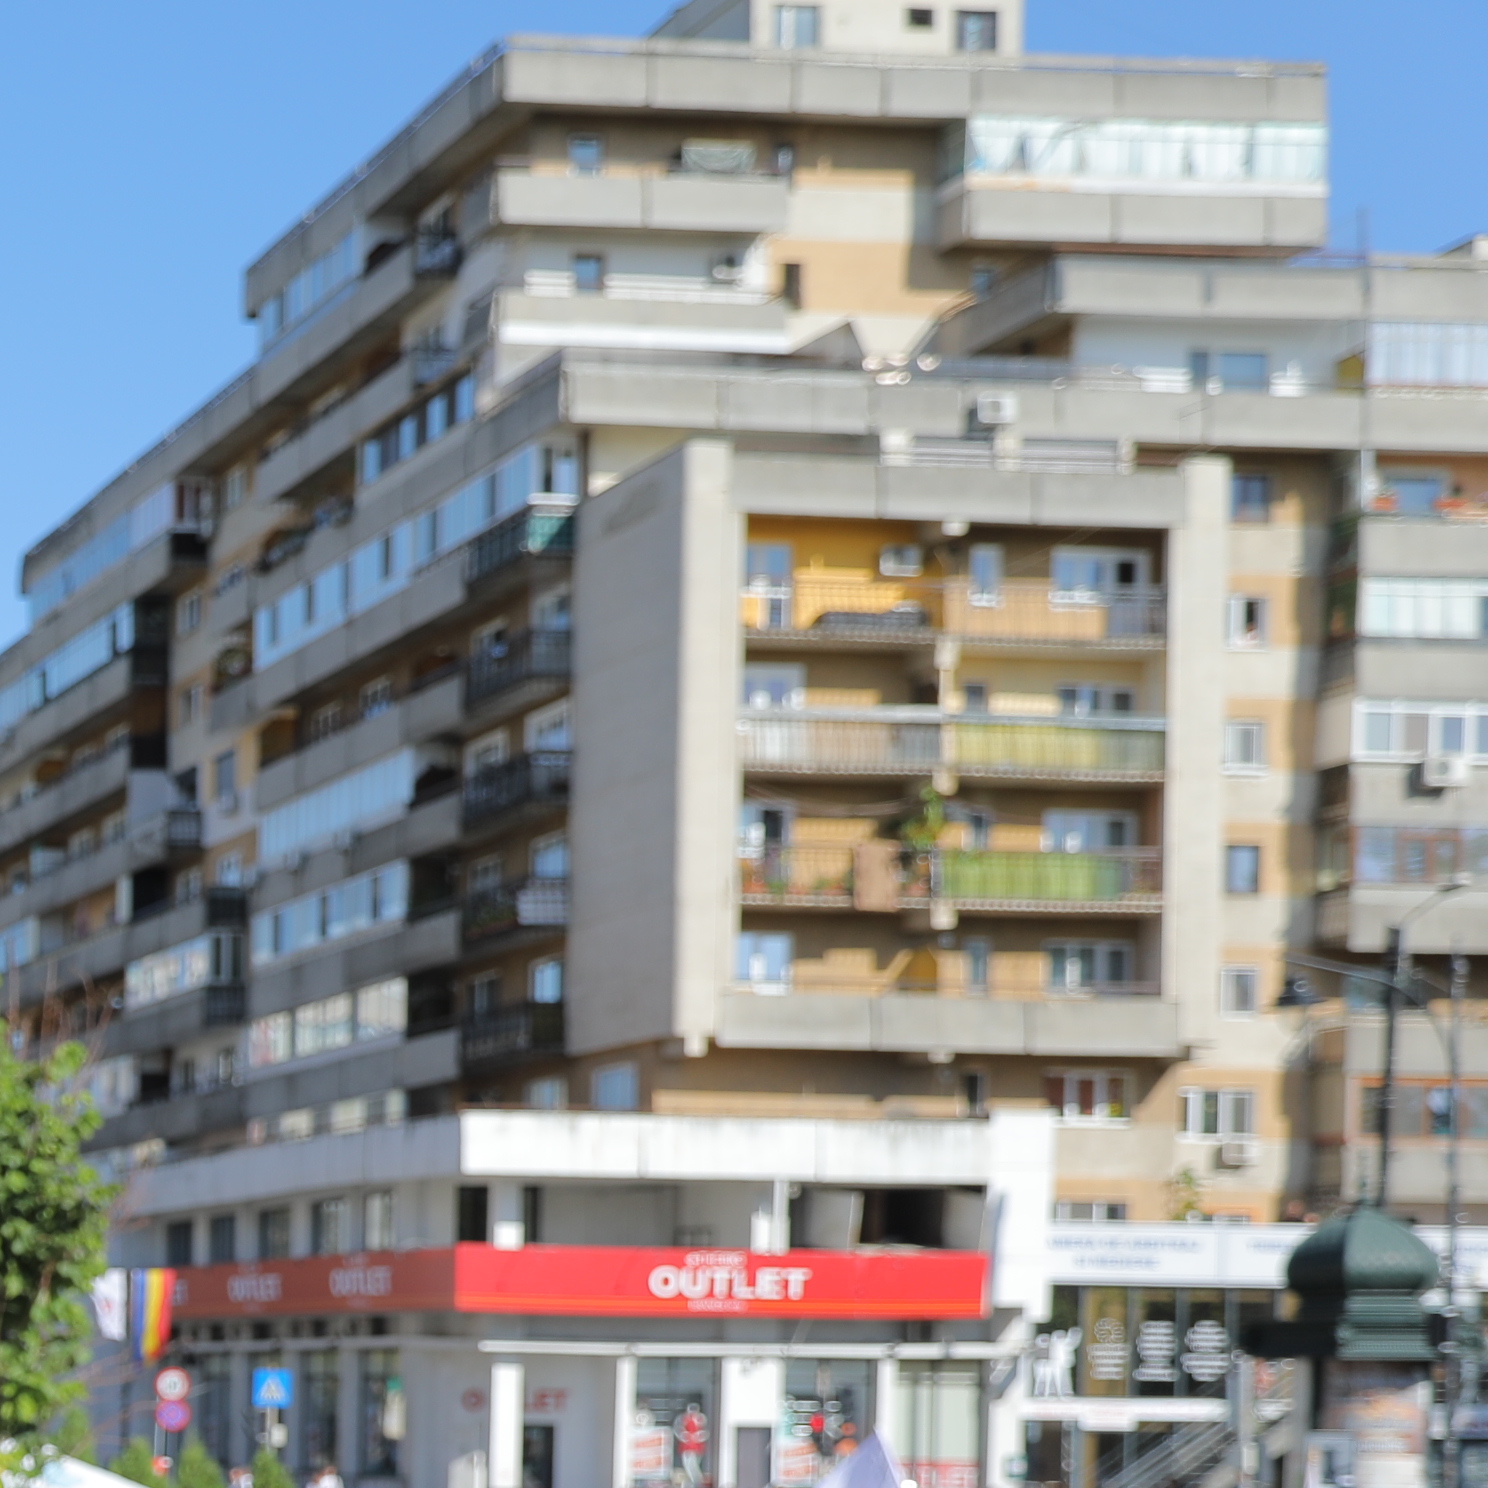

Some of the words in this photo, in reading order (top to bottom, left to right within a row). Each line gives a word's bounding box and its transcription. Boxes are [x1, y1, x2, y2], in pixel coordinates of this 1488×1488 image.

[227, 1272, 283, 1302] OUTLET
[328, 1264, 393, 1298] OUTLET
[648, 1264, 813, 1301] OUTLET
